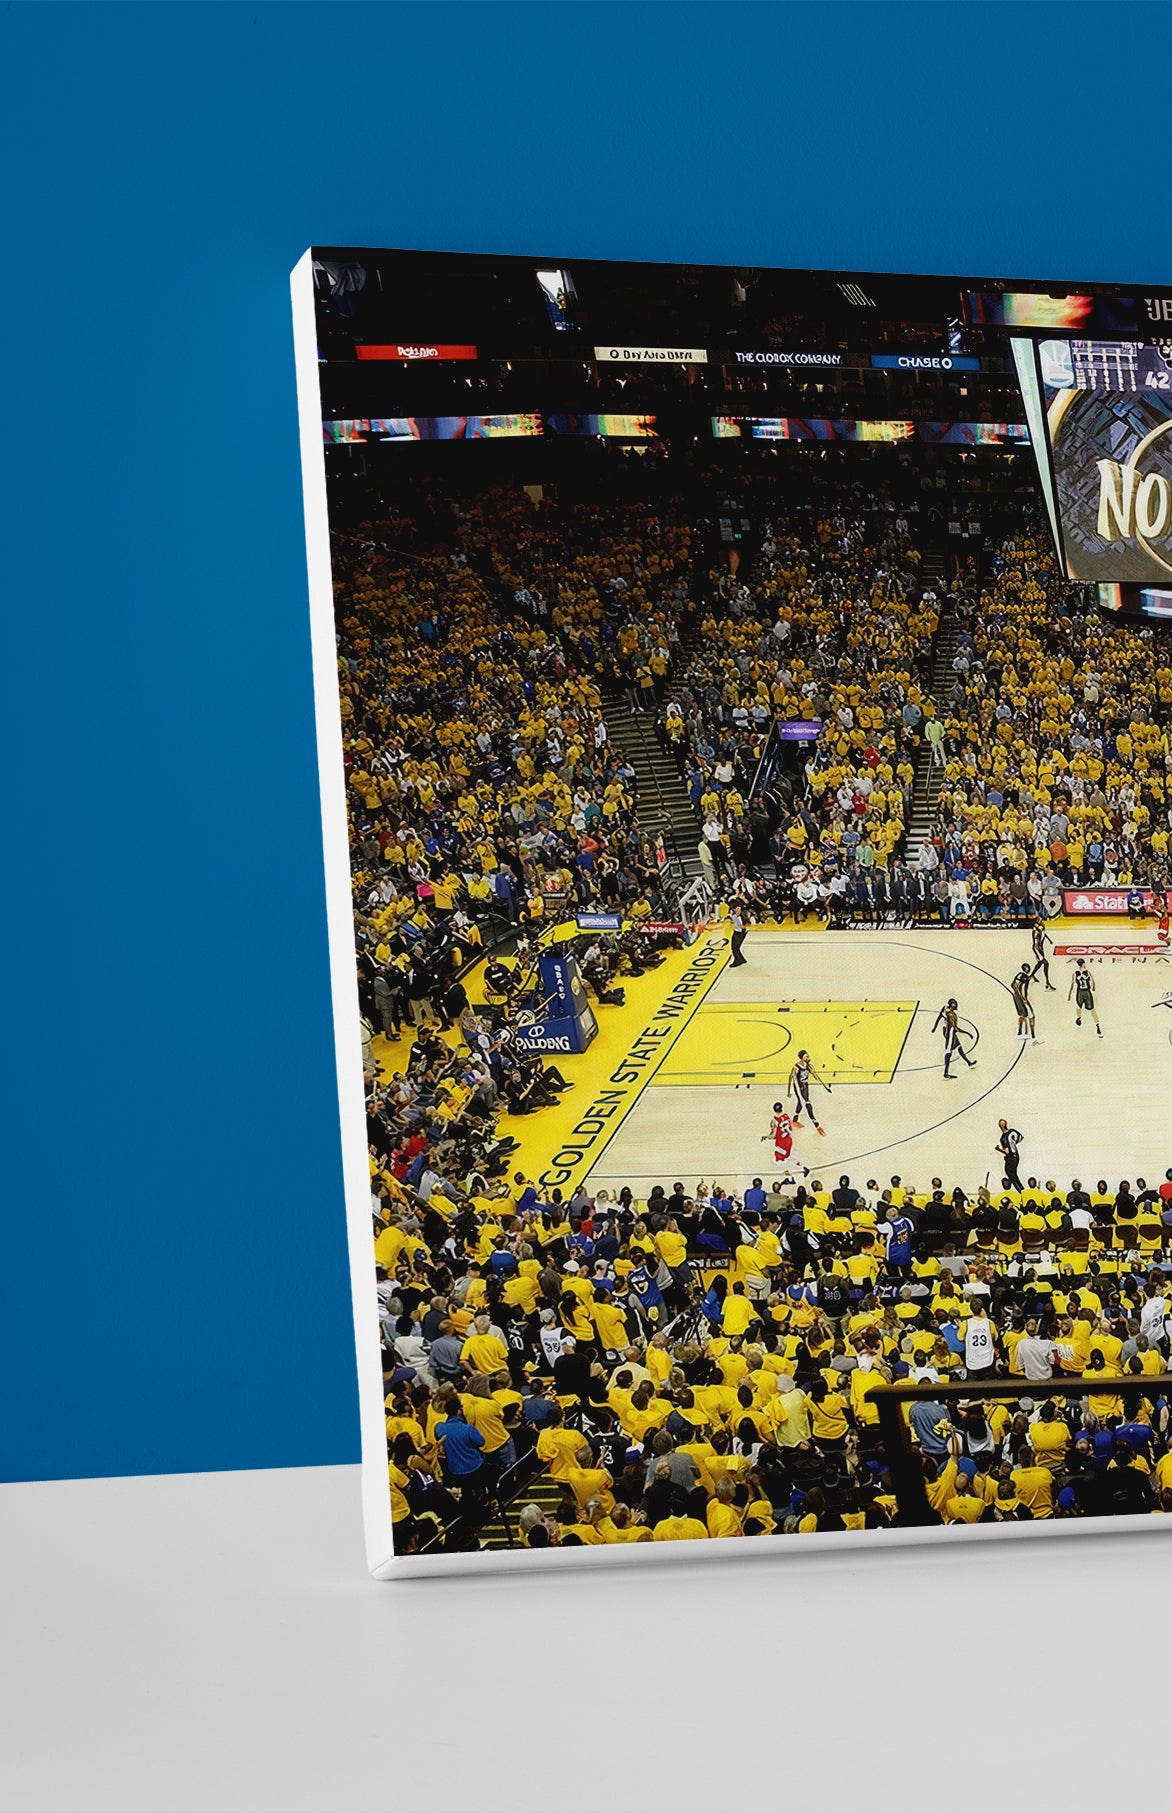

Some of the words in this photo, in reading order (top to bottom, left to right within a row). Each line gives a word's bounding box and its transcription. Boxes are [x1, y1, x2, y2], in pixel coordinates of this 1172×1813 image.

[898, 357, 941, 369] CHASE
[1145, 371, 1171, 389] 42
[538, 1090, 627, 1187] GOLDEN
[609, 1025, 671, 1083] STATE
[653, 937, 730, 1026] WARRIORS
